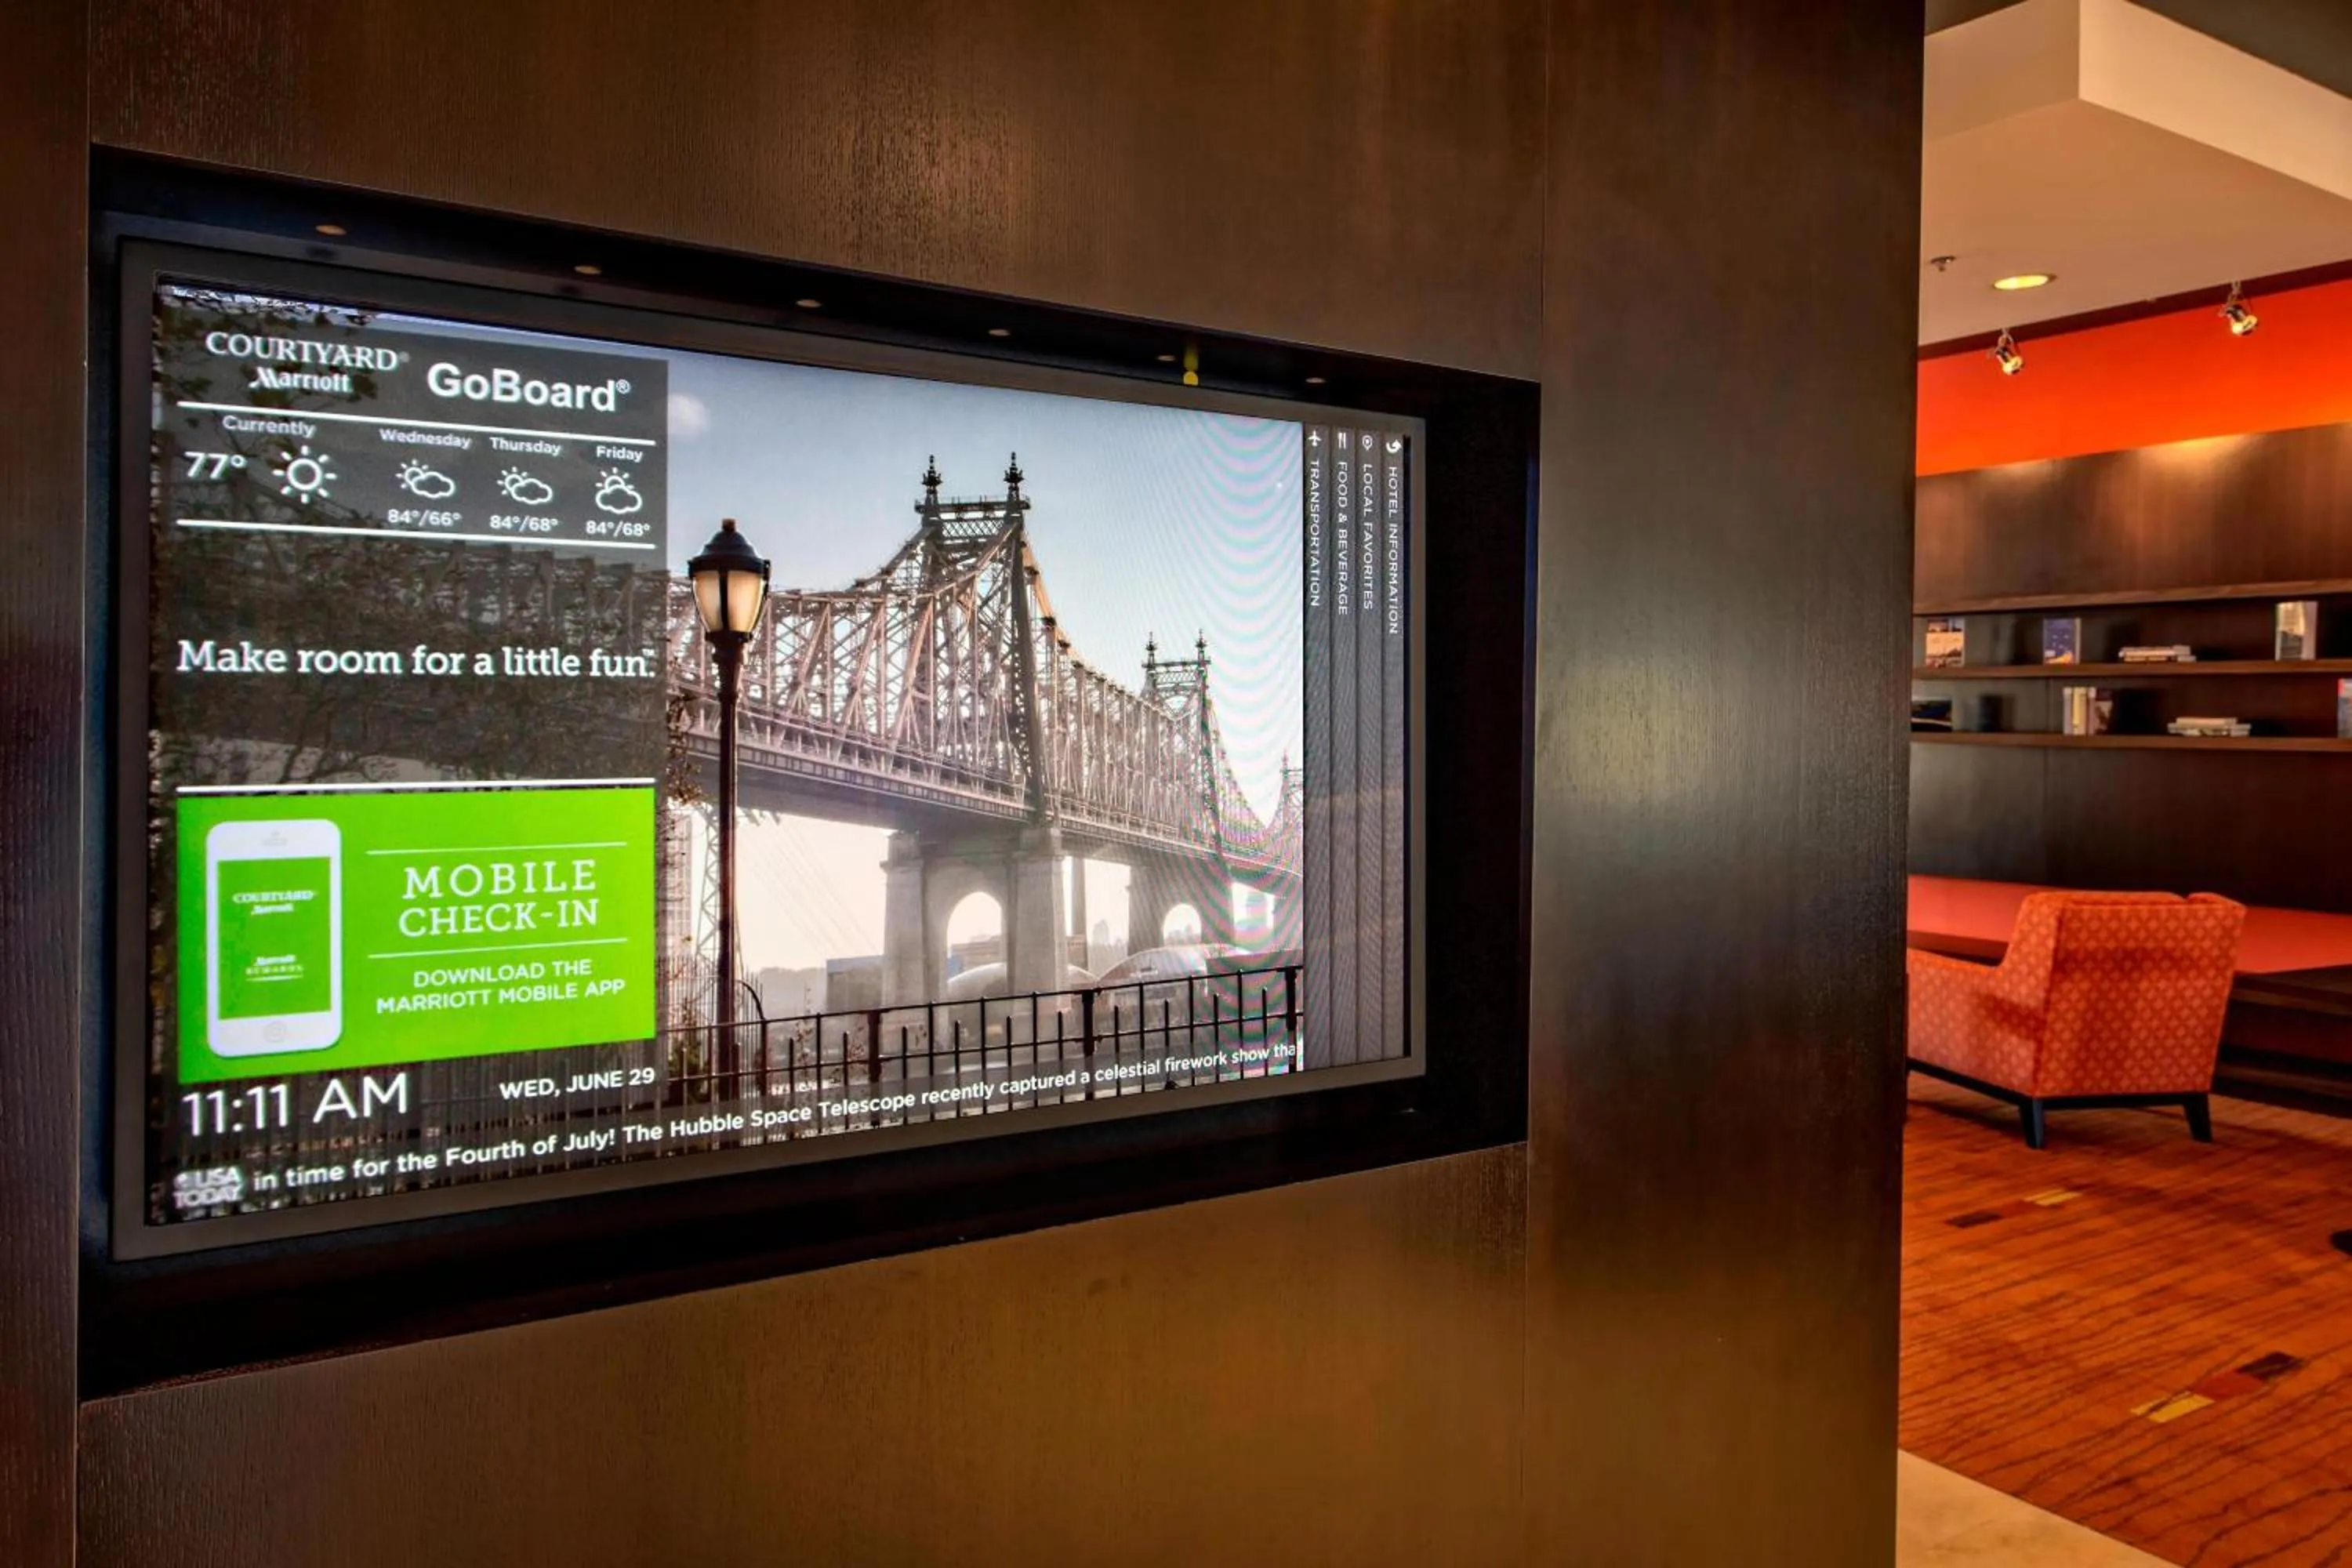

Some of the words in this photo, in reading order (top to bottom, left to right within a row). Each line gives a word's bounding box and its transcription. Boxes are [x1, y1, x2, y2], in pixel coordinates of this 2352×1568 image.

[248, 366, 352, 393] Marriott
[222, 415, 314, 437] Currently
[379, 428, 472, 450] Wednesday
[489, 437, 561, 456] Thursday
[596, 445, 644, 463] Friday
[185, 452, 248, 481] 77°
[1338, 462, 1348, 508] FOOD
[1363, 463, 1373, 517] LOCAL
[1388, 466, 1399, 518] HOTEL
[388, 508, 462, 527] 84°/66°
[490, 514, 558, 532] 84°/68°
[586, 520, 651, 538] 84°/68°
[1309, 459, 1320, 607] TRANSPORTATION
[1338, 513, 1348, 524] &
[1338, 529, 1348, 615] BEVERAGE
[1363, 523, 1373, 610] FAVORITES
[1388, 524, 1399, 634] INFORMATION
[176, 640, 287, 673] Make
[297, 651, 402, 674] room
[412, 645, 464, 675] for
[474, 655, 495, 676] a
[503, 648, 582, 677] little
[403, 859, 596, 900] MOBILE
[398, 898, 600, 938] CHECK-IN
[413, 963, 545, 989] DOWNLOAD
[552, 959, 592, 977] THE
[376, 989, 491, 1014] MARRIOTT
[499, 982, 579, 1004] MOBILE
[585, 978, 625, 996] APP
[499, 1080, 561, 1099] WED,
[565, 1073, 623, 1093] JUNE
[629, 1067, 655, 1085] 29
[182, 1083, 289, 1137] 11:11
[314, 1073, 408, 1123] AM
[253, 1171, 278, 1191] in
[285, 1163, 344, 1187] time
[353, 1158, 390, 1178] for
[396, 1152, 438, 1172] the
[445, 1141, 526, 1167] Fourth
[532, 1135, 557, 1156] of
[561, 1128, 617, 1159] July!
[622, 1123, 663, 1143] The
[670, 1112, 746, 1135] Hubble
[750, 1104, 814, 1134] Space
[818, 1091, 916, 1123] Telescope
[921, 1082, 995, 1105] recently
[999, 1069, 1076, 1098] captured
[1080, 1070, 1091, 1083] a
[1094, 1059, 1162, 1082] celestial
[1165, 1051, 1228, 1073] firework
[1231, 1048, 1270, 1064] show
[172, 1184, 241, 1209] TODAY
